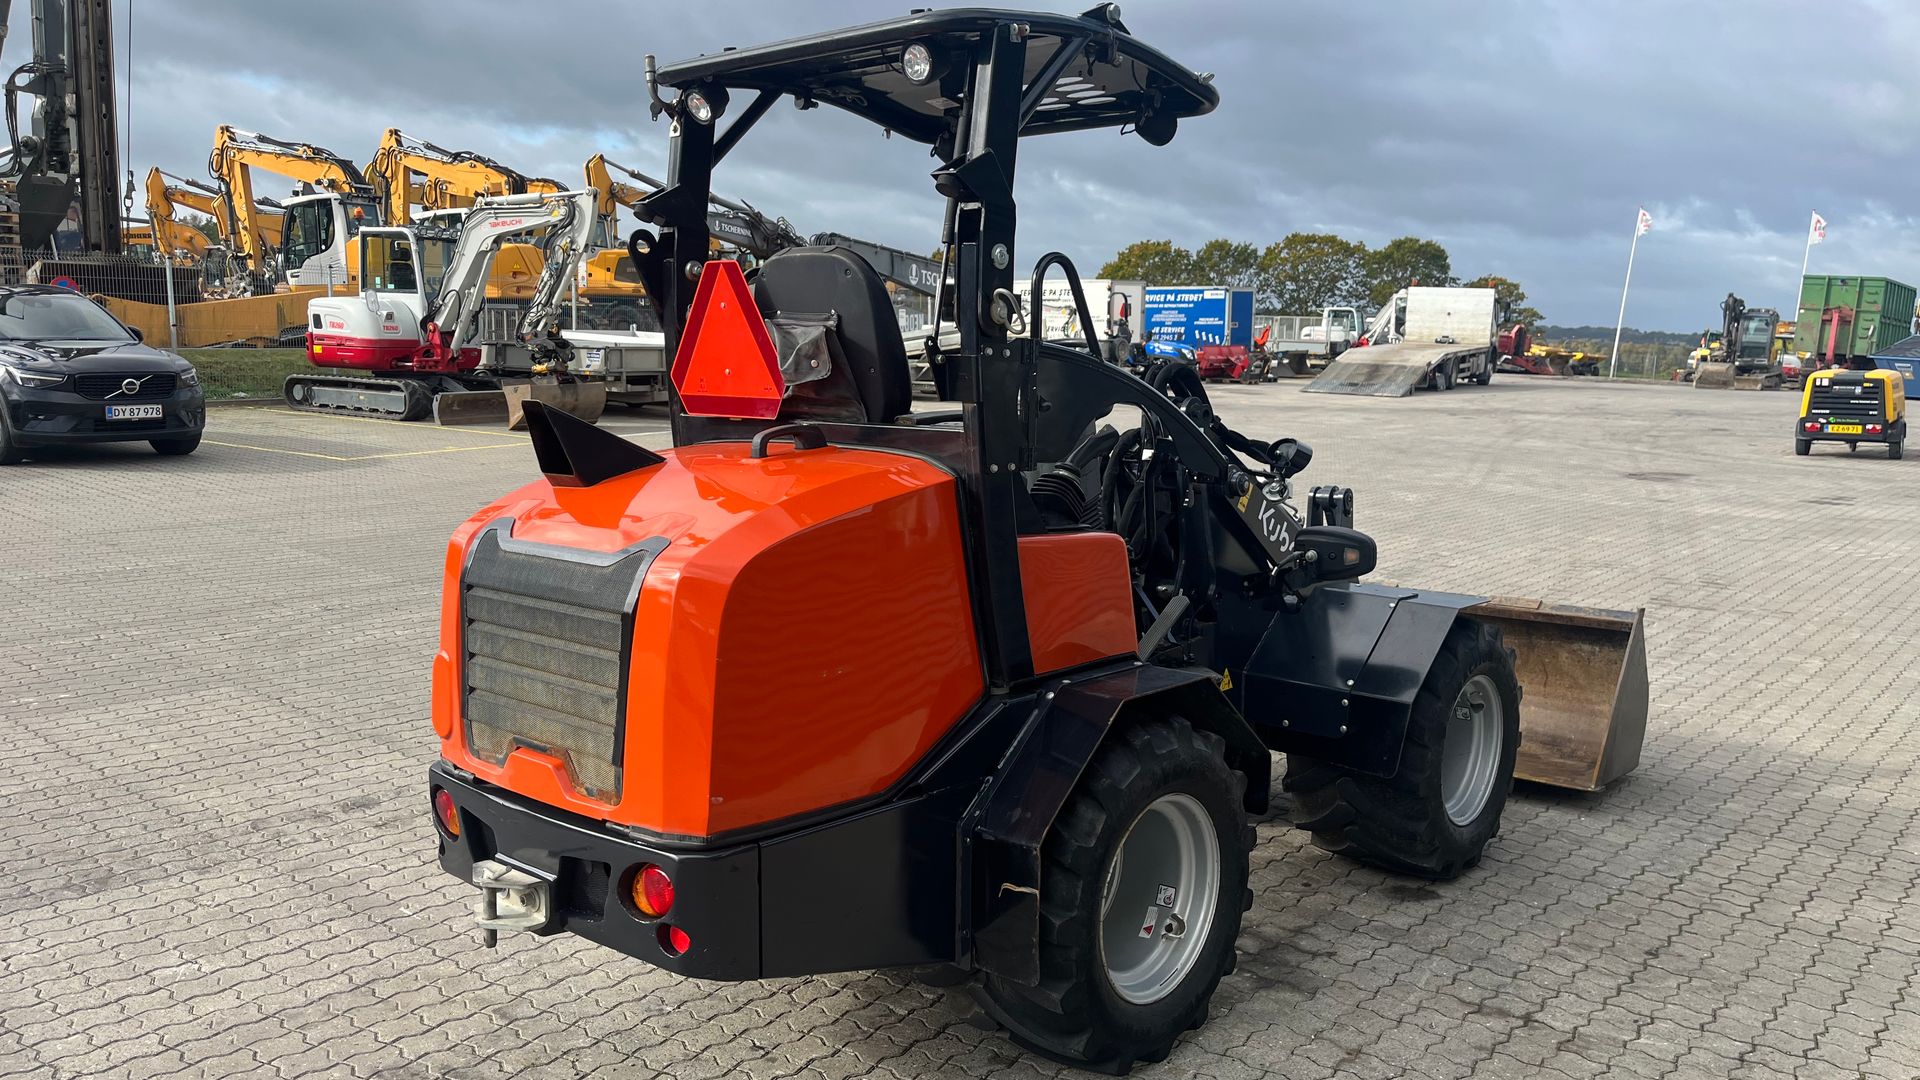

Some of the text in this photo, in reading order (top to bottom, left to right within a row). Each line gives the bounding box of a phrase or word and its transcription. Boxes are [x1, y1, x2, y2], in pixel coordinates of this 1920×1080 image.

[489, 218, 523, 228] TAKEUCHI
[721, 222, 753, 238] TSCHERNIN
[1145, 293, 1165, 302] RVICE
[1176, 293, 1203, 302] STEDET
[328, 321, 345, 329] TB260
[1161, 326, 1186, 334] SERVICE
[113, 406, 161, 417] DY 87 978
